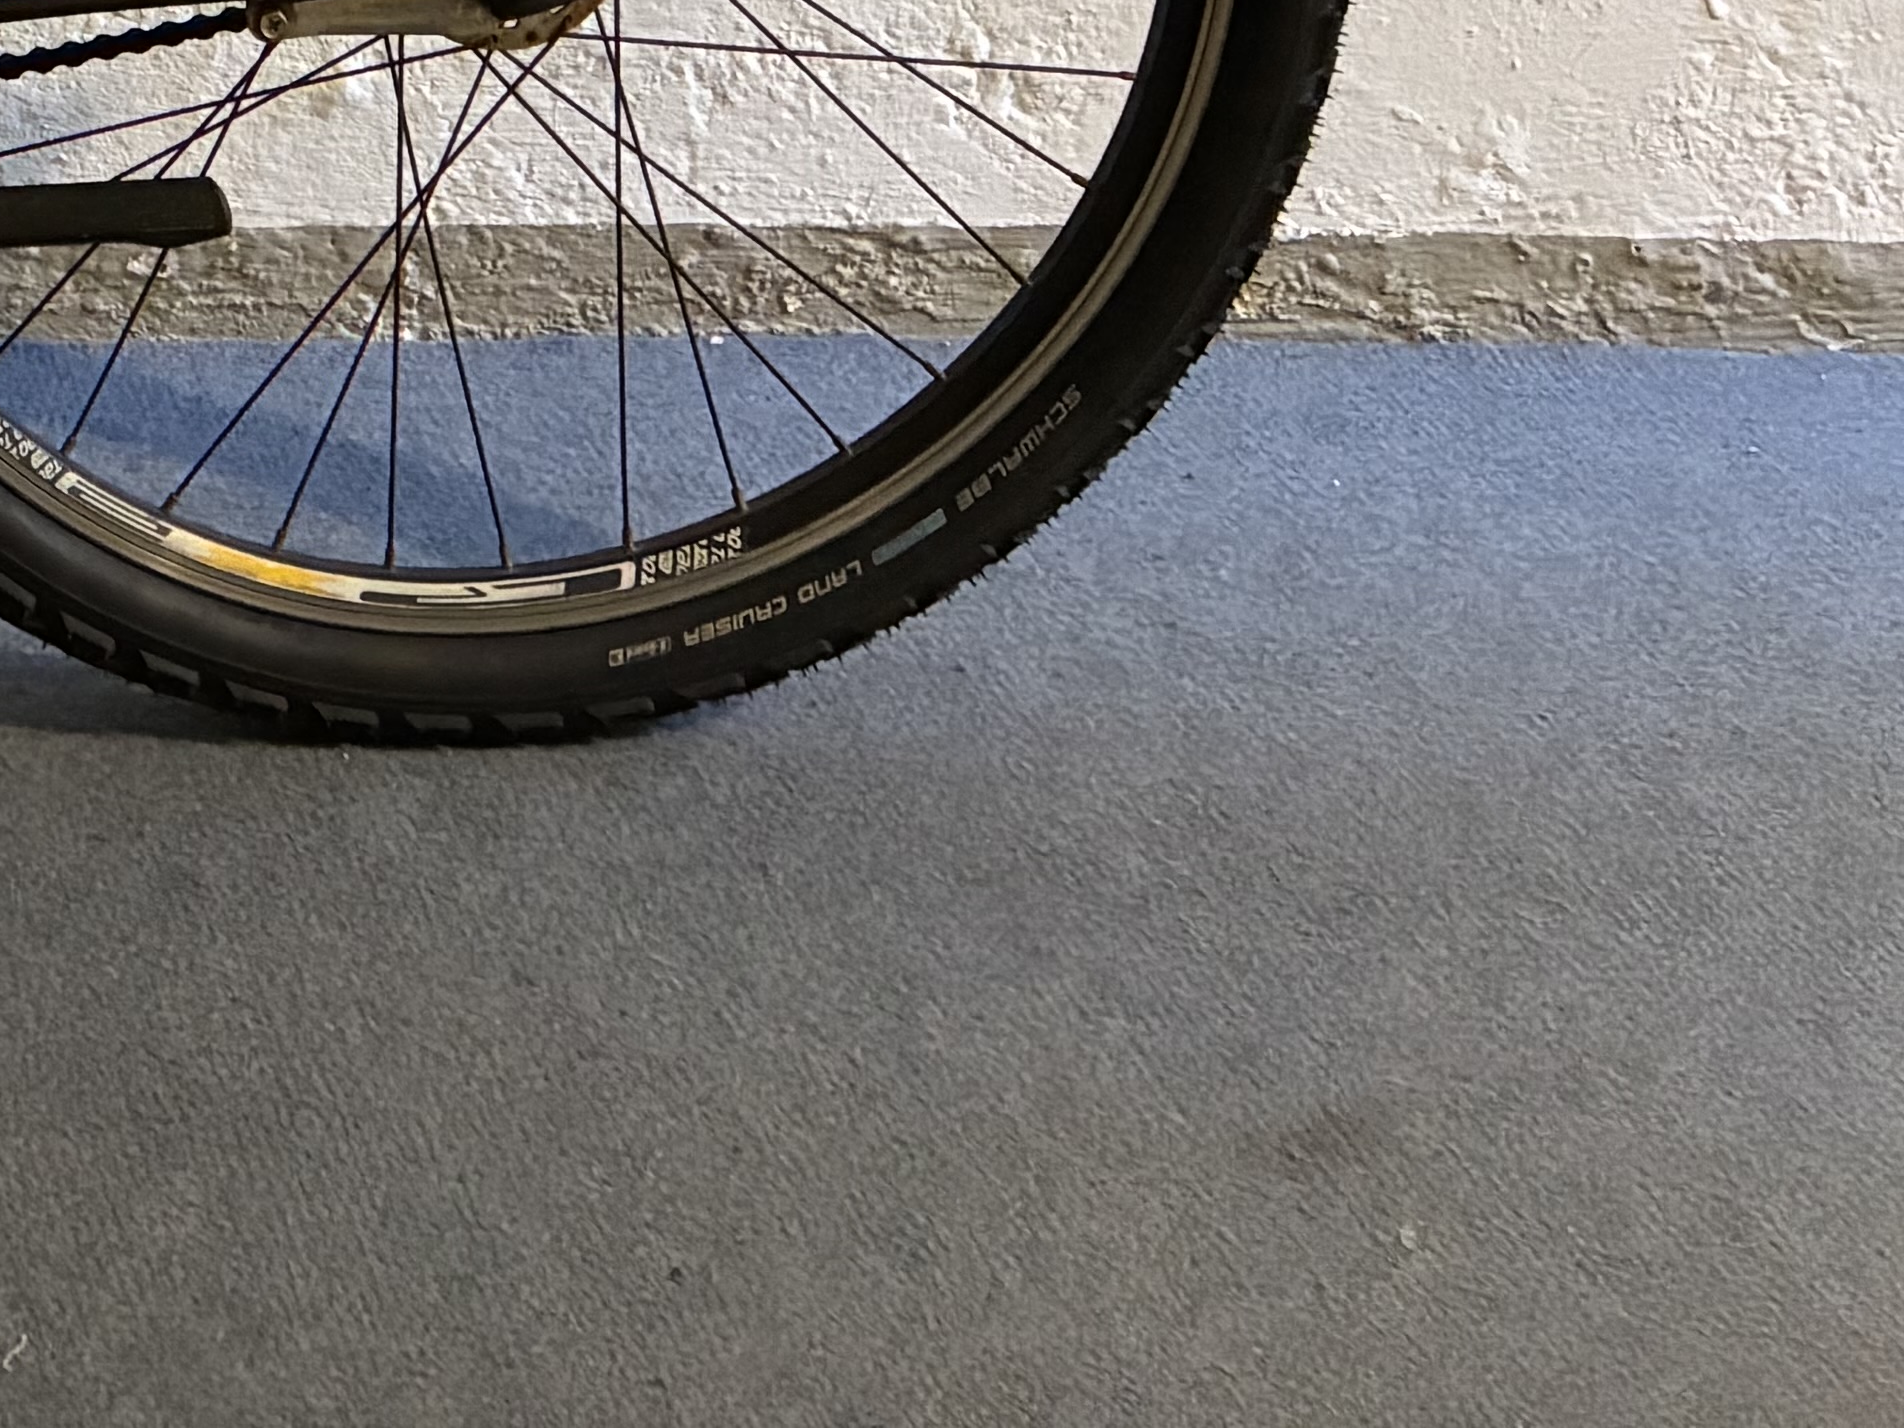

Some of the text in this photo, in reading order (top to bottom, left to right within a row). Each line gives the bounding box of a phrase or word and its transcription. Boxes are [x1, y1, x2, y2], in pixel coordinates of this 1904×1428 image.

[683, 383, 1082, 647] SCHWALBE LAND CRUISER
